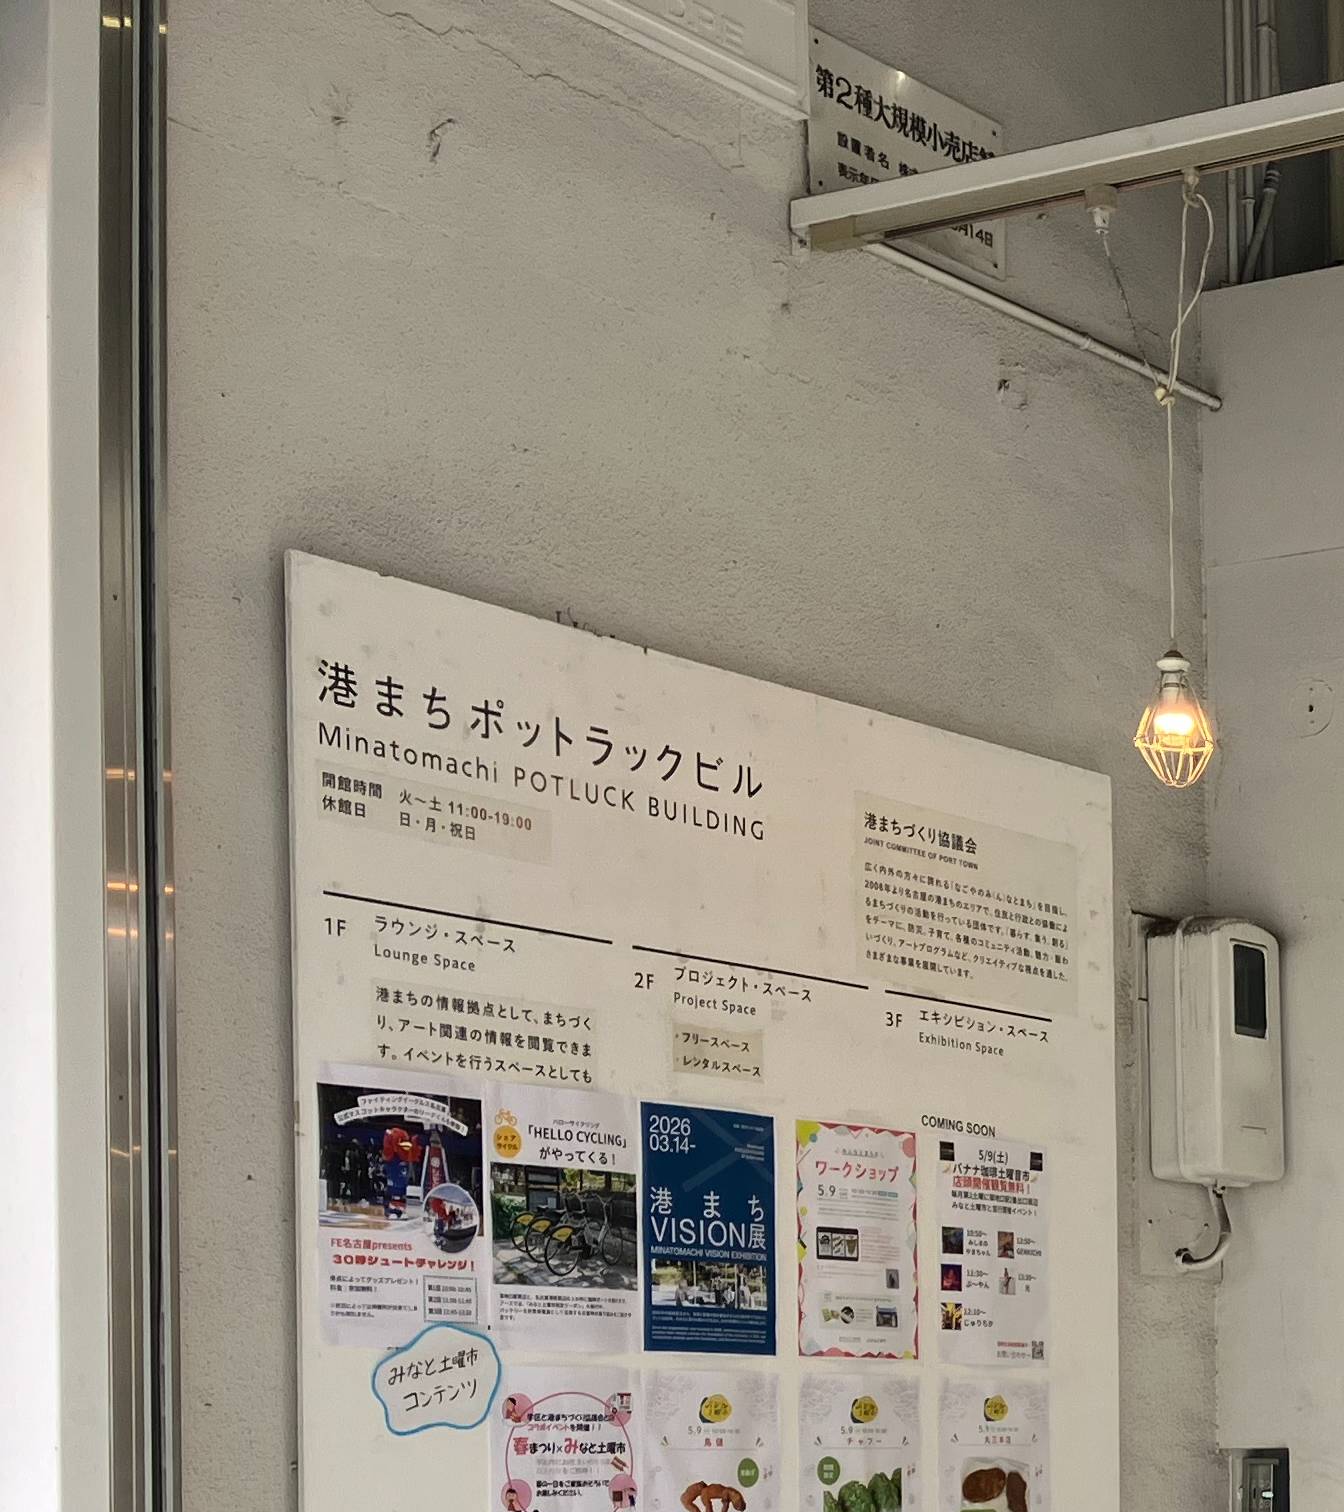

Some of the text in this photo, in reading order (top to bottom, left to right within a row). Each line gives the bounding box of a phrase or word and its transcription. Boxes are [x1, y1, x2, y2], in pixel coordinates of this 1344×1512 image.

[318, 658, 763, 799] 港まちポットラックビル
[318, 722, 765, 841] Minatomachi POTLUCK BUILDING
[321, 771, 383, 800] 開館時間
[321, 795, 367, 819] 休館日
[864, 811, 978, 855] 港まちづくり協議会
[323, 915, 516, 953] 1F ラウンジ・スペース
[374, 944, 476, 972] Lounge Space
[634, 966, 812, 1003] 2F プロジェクト・スペース
[673, 991, 757, 1016] Project Space
[885, 1009, 1050, 1043] 3F エキシビション・スペース
[918, 1031, 1005, 1057] Exhibition Space
[650, 1115, 691, 1137] 2026
[921, 1114, 996, 1138] COMING SOON
[388, 1347, 479, 1386] みなと土曜市
[403, 1378, 478, 1412] コンテンツ
